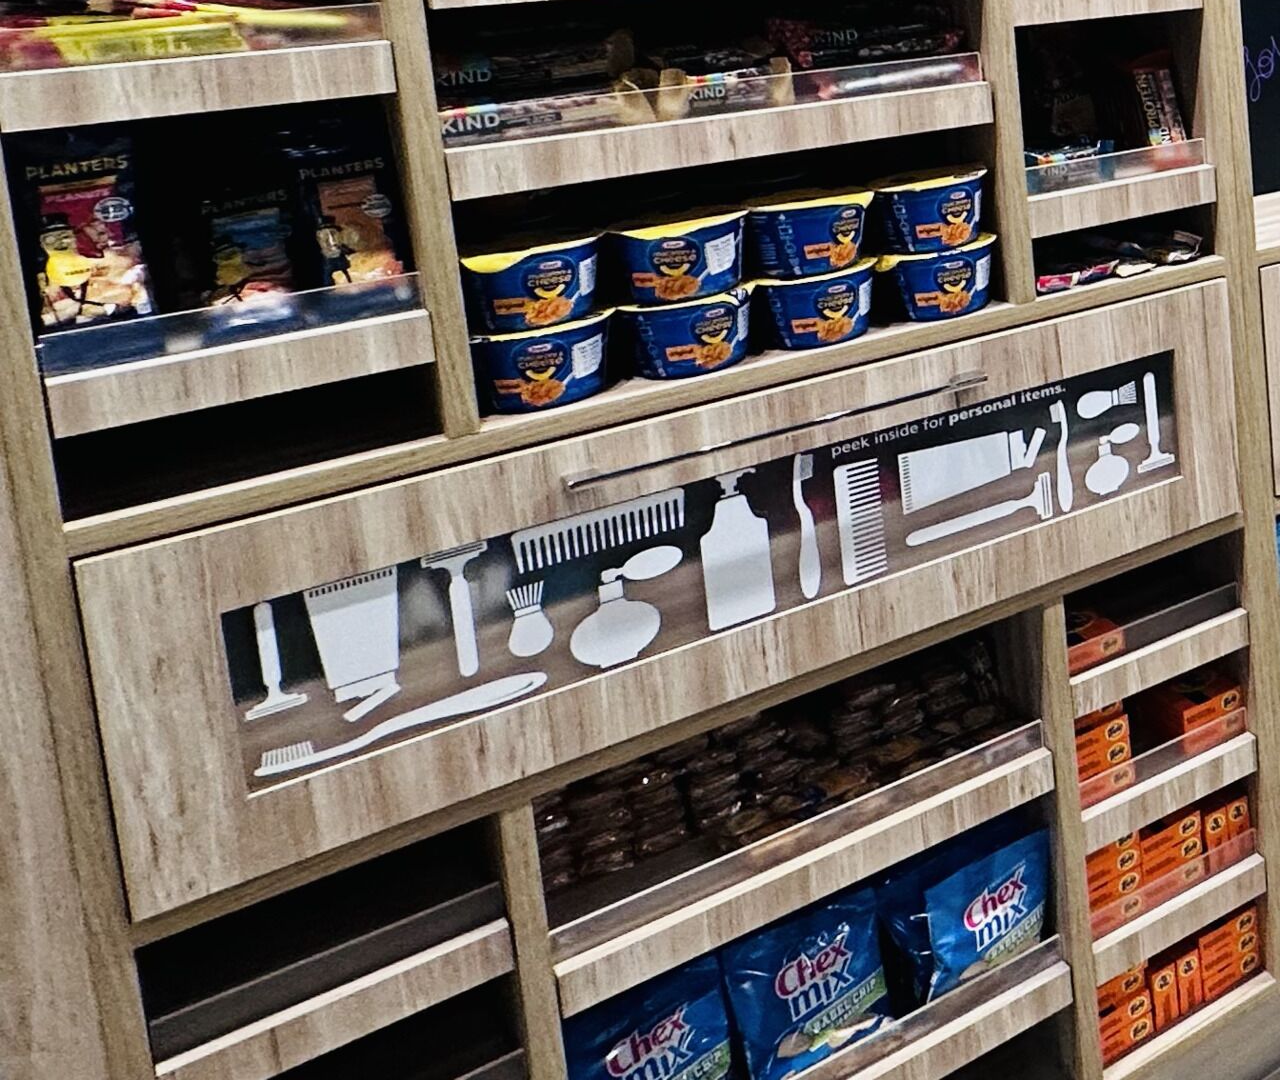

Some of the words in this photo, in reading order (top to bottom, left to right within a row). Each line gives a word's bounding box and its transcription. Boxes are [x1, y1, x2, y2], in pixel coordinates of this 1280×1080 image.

[25, 155, 129, 181] PLANTERS
[299, 156, 385, 180] PLANTERS
[831, 437, 870, 457] peek
[874, 424, 918, 445] inside
[922, 416, 944, 430] for
[947, 397, 1017, 427] personal
[1021, 384, 1066, 404] items.
[964, 865, 1028, 932] Chex
[774, 932, 851, 999] Chex
[605, 1003, 688, 1076] Chex
